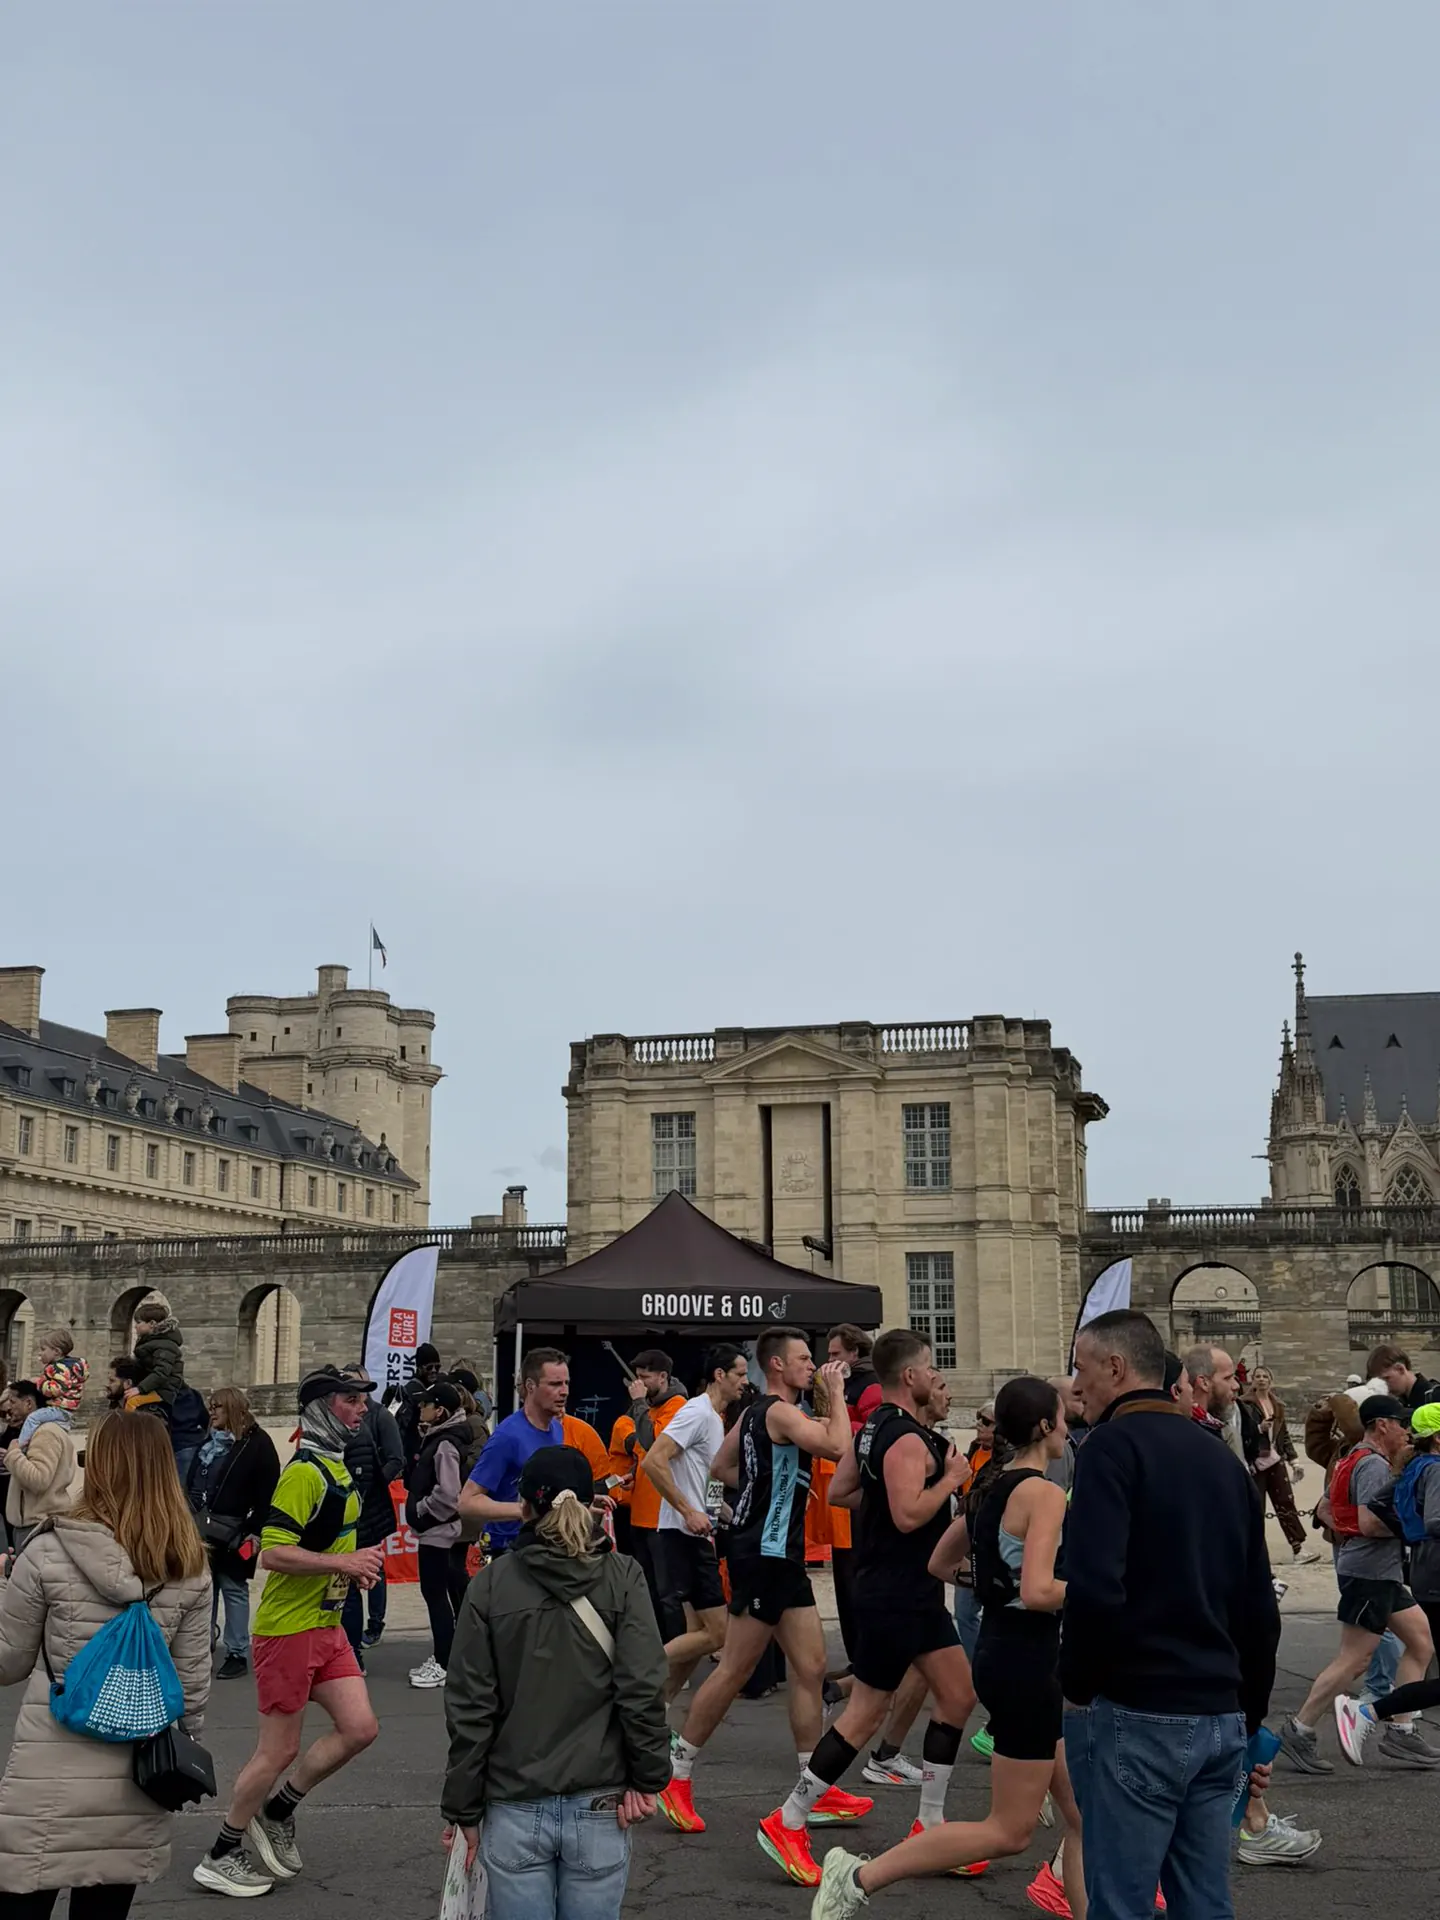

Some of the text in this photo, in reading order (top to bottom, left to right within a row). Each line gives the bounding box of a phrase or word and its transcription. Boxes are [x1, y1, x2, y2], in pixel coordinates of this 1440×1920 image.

[641, 1294, 763, 1317] GROOVE & GO
[391, 1312, 403, 1343] FOR A
[402, 1313, 415, 1344] CURE
[403, 1353, 416, 1380] UK
